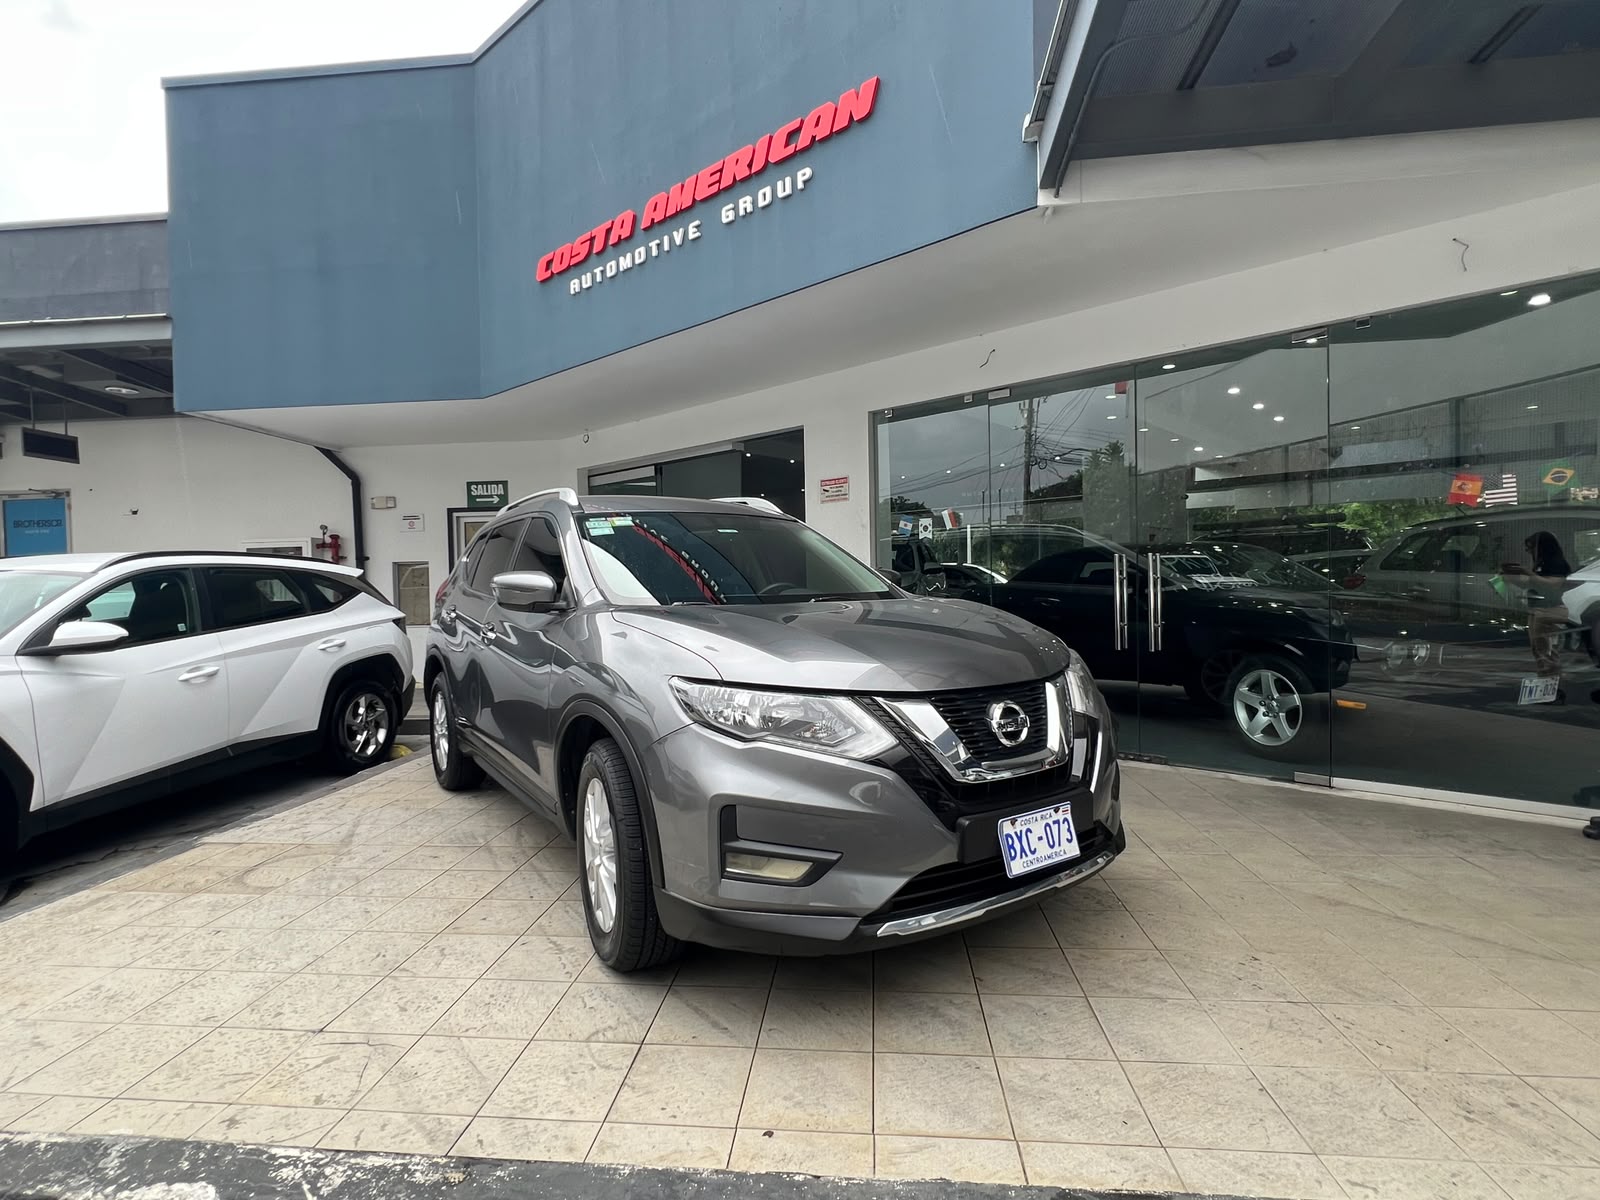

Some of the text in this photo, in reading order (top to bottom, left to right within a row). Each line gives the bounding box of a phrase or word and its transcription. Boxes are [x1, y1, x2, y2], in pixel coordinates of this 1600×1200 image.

[535, 75, 880, 283] COSTA AMERICAN
[569, 166, 813, 295] AUTOMOTIVE GROUP
[470, 484, 504, 496] SALIDA
[1020, 811, 1053, 826] COSTA RICA
[1004, 817, 1073, 862] BXC-073
[1022, 849, 1067, 868] CENTROAMERICA
